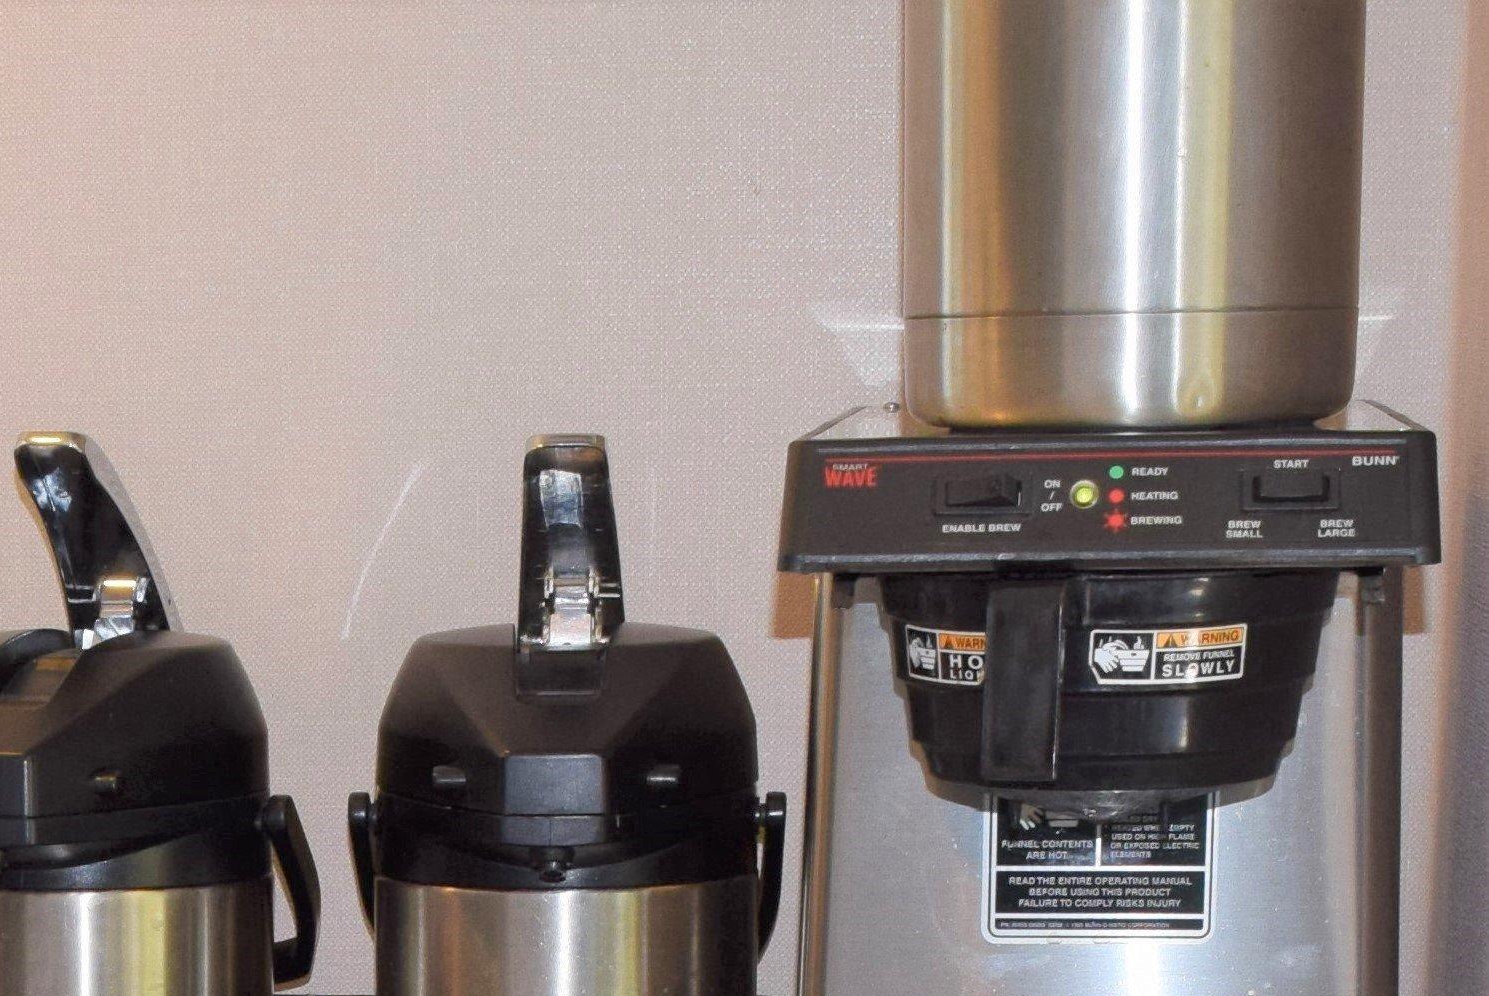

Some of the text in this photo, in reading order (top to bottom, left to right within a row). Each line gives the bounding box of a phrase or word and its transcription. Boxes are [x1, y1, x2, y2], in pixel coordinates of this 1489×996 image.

[1273, 459, 1309, 469] START
[1131, 467, 1168, 476] READY
[825, 466, 878, 488] WAVE
[1044, 479, 1060, 488] ON
[1130, 491, 1178, 500] HEATING
[1041, 503, 1062, 512] OFF
[1130, 516, 1182, 525] BREWING
[1227, 520, 1261, 529] BREW
[1320, 519, 1353, 528] BREW
[942, 523, 1021, 533] ENABLE BREW
[1226, 530, 1262, 538] SMALL
[1318, 529, 1355, 538] LARGE
[1180, 630, 1240, 645] WRNING
[1163, 649, 1235, 662] REMOVE FUNNEL
[1162, 659, 1236, 679] SLOWLY
[1042, 840, 1094, 848] CONTENTS
[1026, 851, 1046, 859] ARE
[1009, 877, 1192, 885] READ THE ENTIRE OPERATING MANUAL
[1028, 888, 1171, 896] BEFORE USING THIS PRODUCT
[1018, 899, 1181, 908] FAILURE TO COMPLY RISKS INJURY
